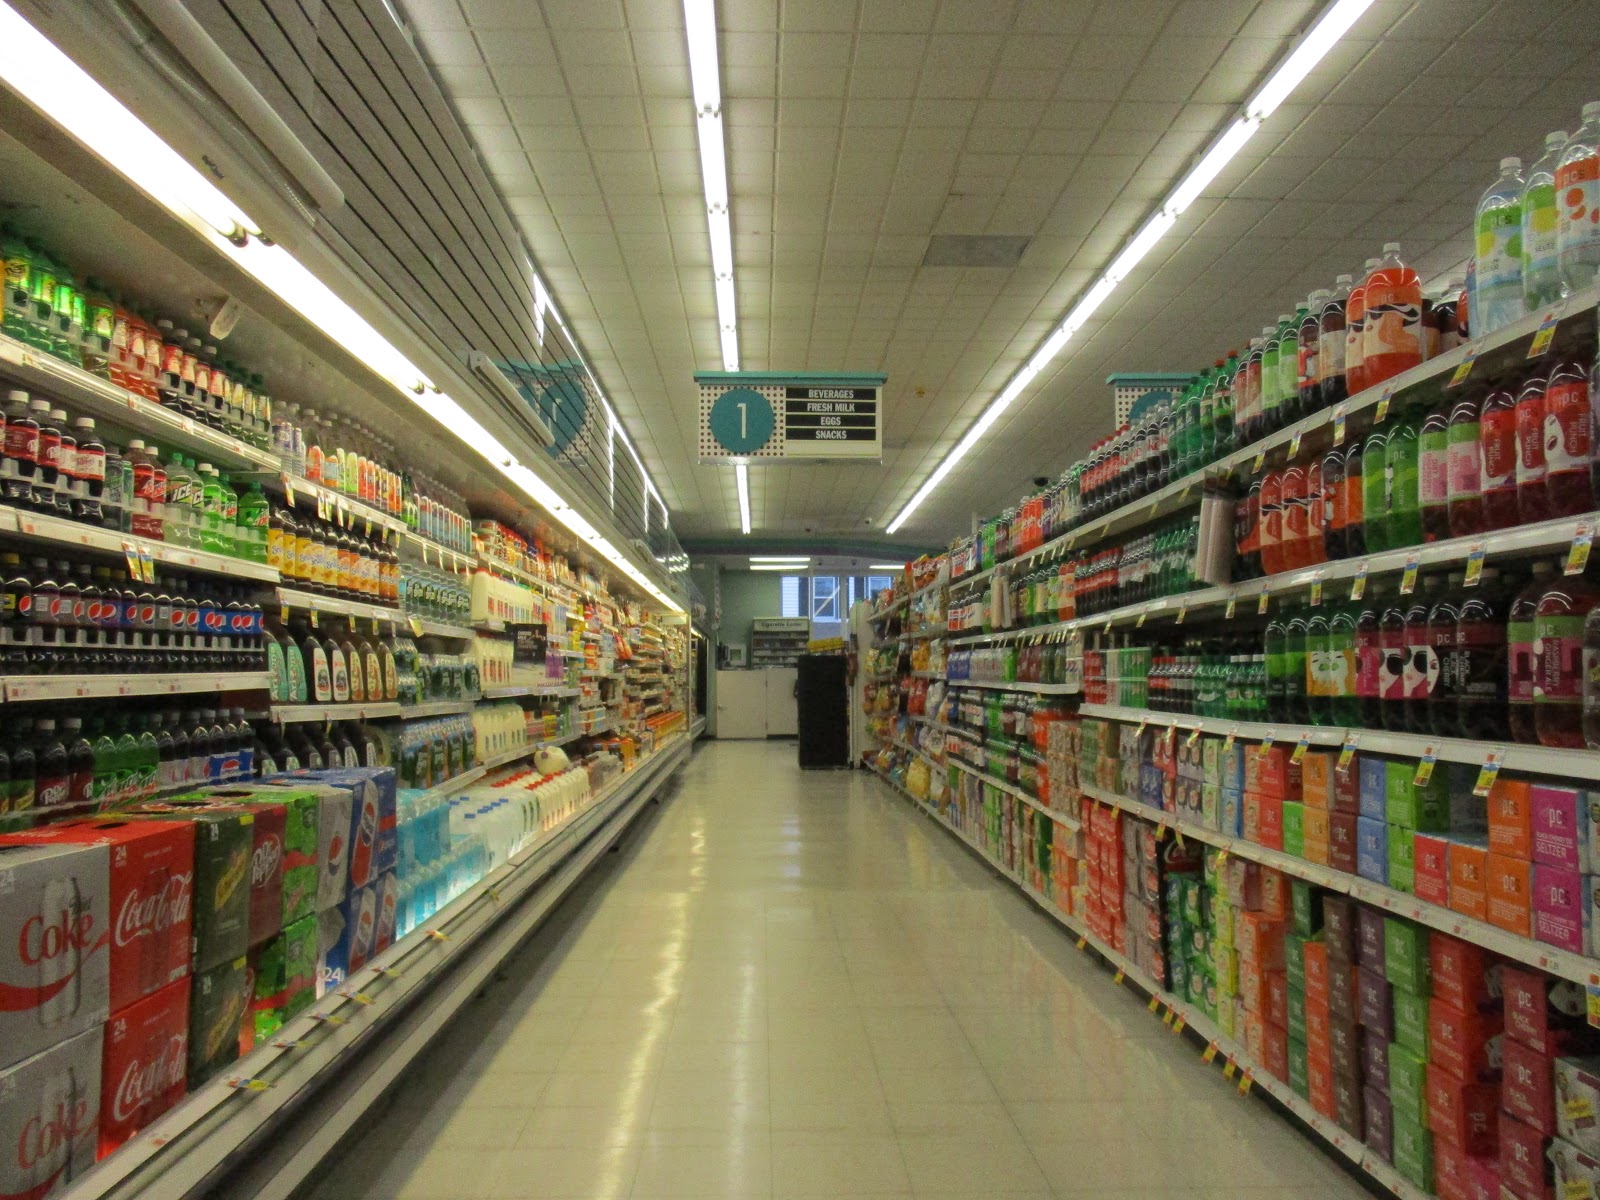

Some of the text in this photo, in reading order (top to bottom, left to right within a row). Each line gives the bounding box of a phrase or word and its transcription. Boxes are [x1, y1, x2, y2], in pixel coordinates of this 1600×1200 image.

[808, 389, 855, 399] BEVERAGES
[807, 402, 856, 413] FRESH MILK
[737, 402, 747, 439] 1
[820, 416, 842, 426] EGGS
[815, 430, 848, 440] SNACKS
[172, 483, 192, 502] ICE
[115, 846, 127, 862] 24
[1536, 841, 1567, 859] SELTZER
[18, 909, 96, 967] Coke
[1538, 920, 1570, 941] SELTZER
[324, 967, 341, 982] 24
[113, 1018, 127, 1036] 24
